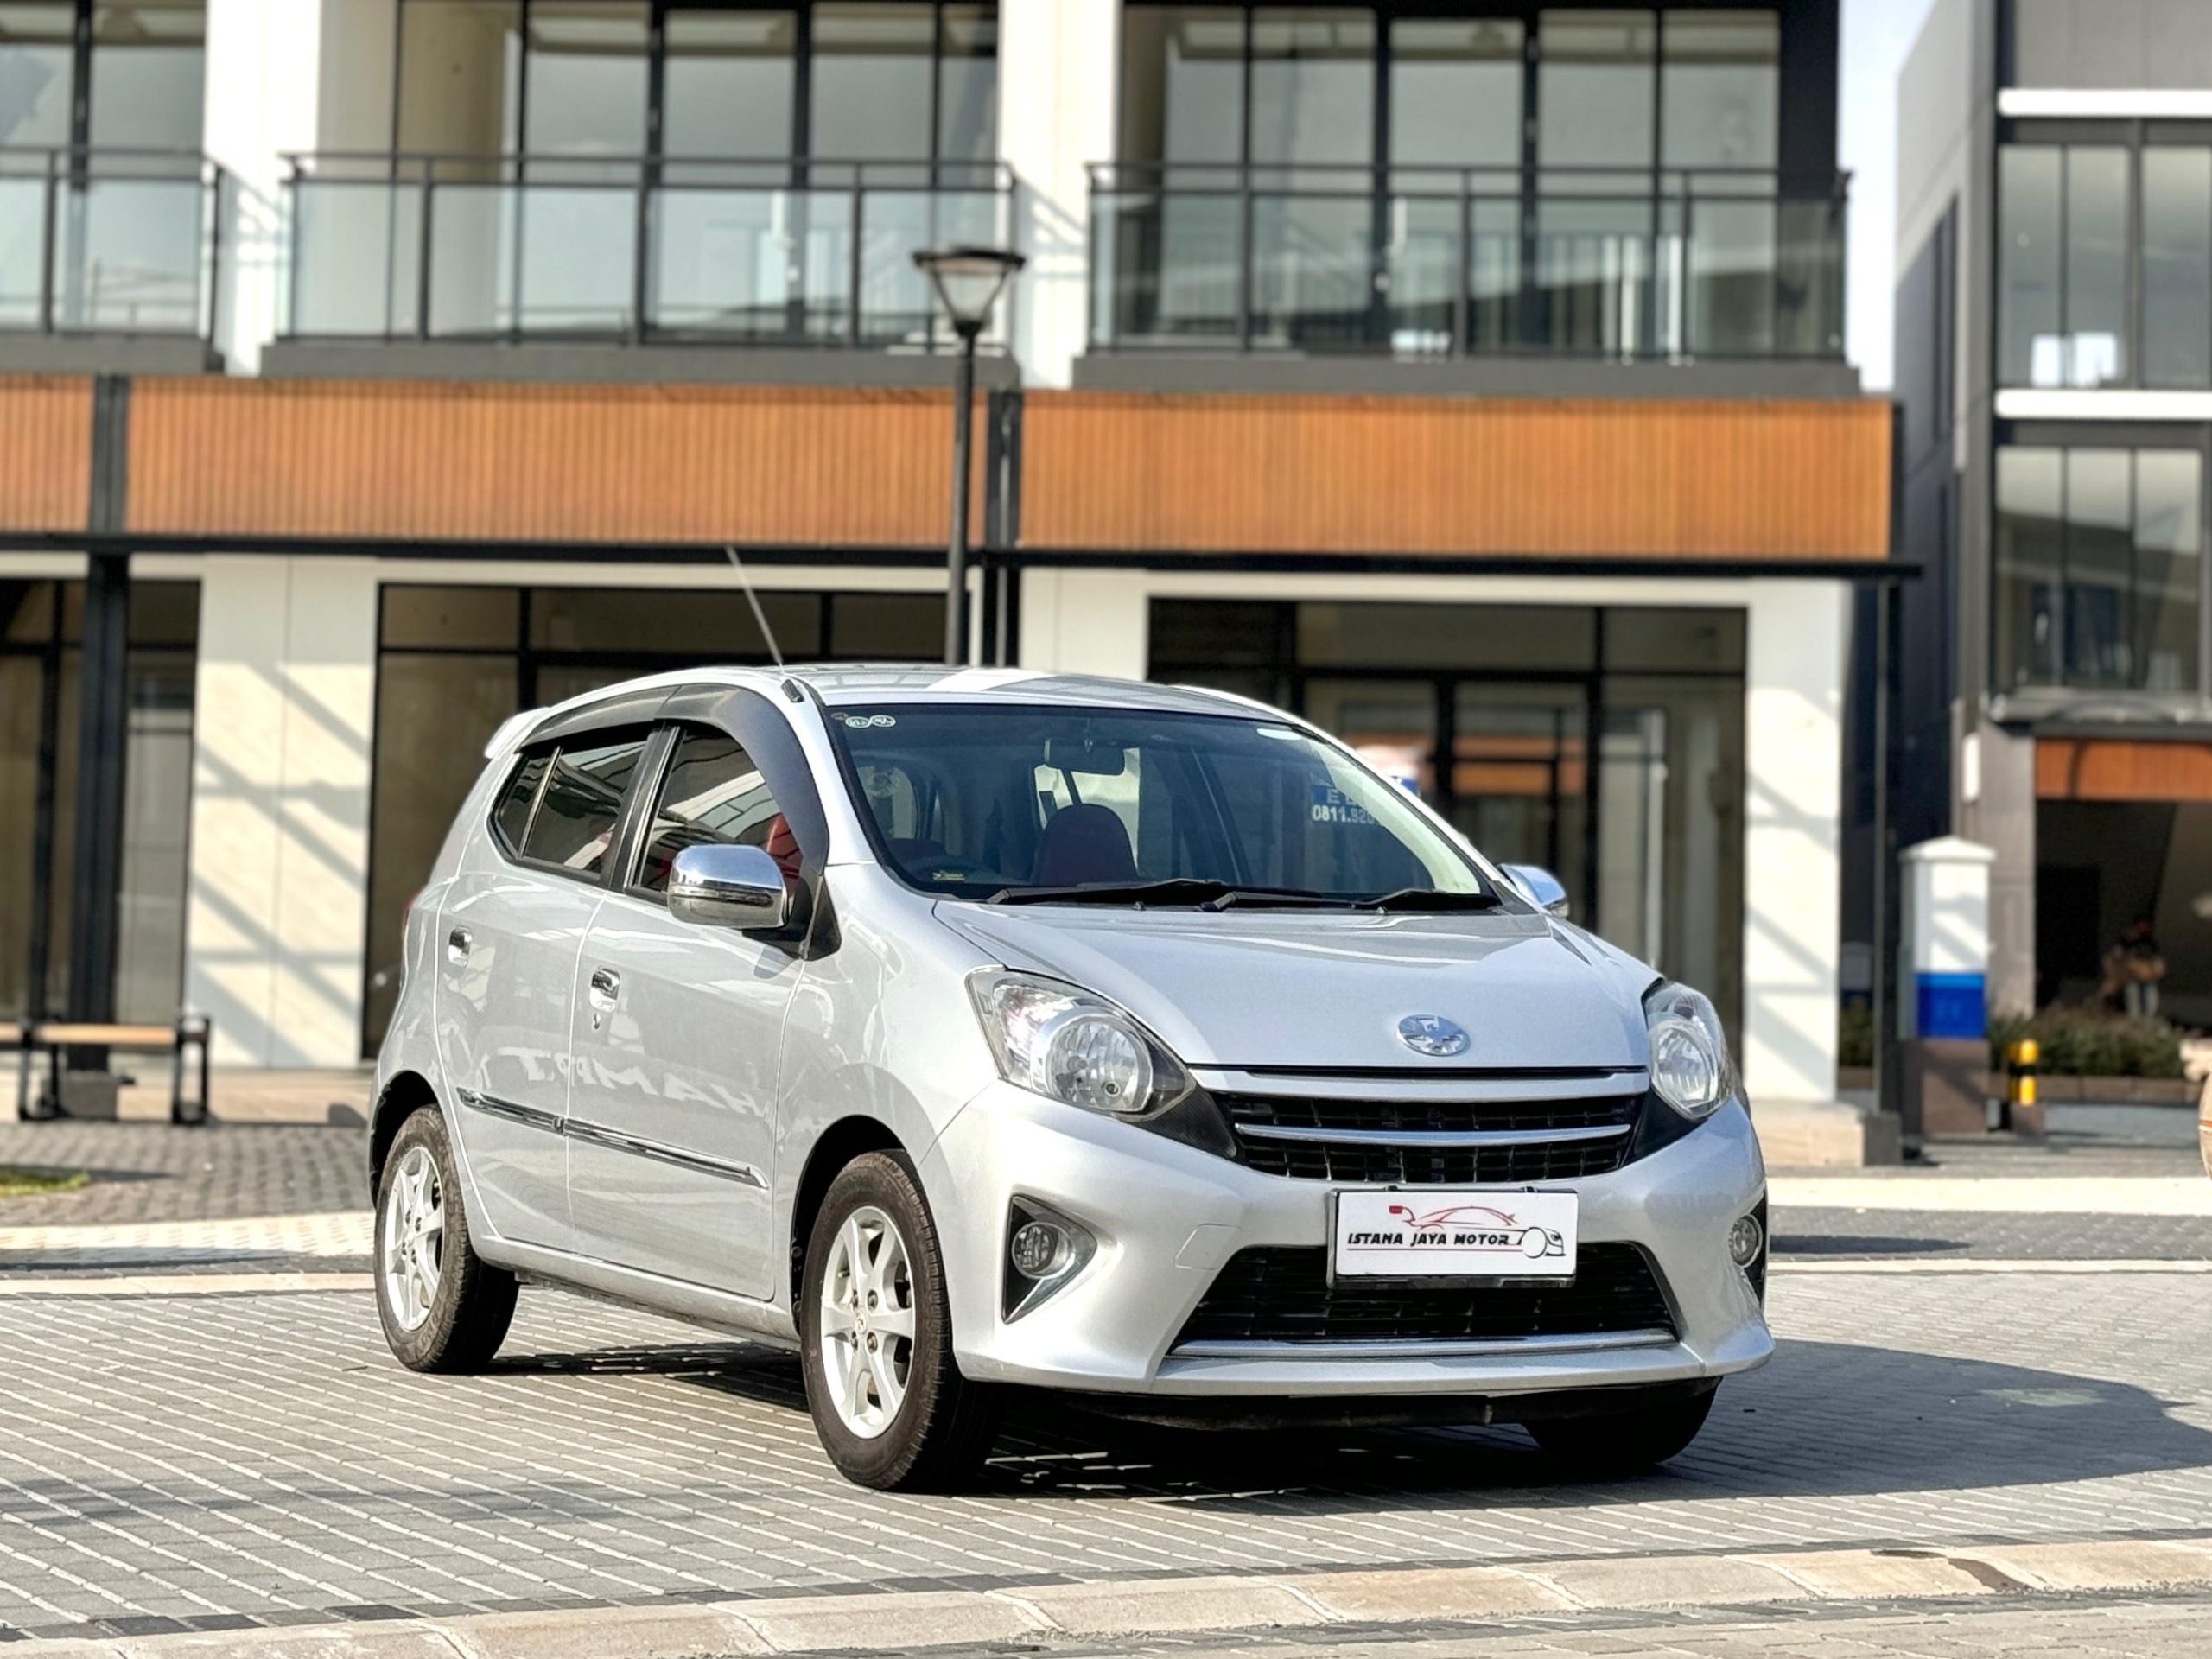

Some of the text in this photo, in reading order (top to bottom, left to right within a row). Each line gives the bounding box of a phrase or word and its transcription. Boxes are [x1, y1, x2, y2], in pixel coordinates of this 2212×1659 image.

[1347, 1232, 1510, 1247] ISTANA JAYA MOTOR
